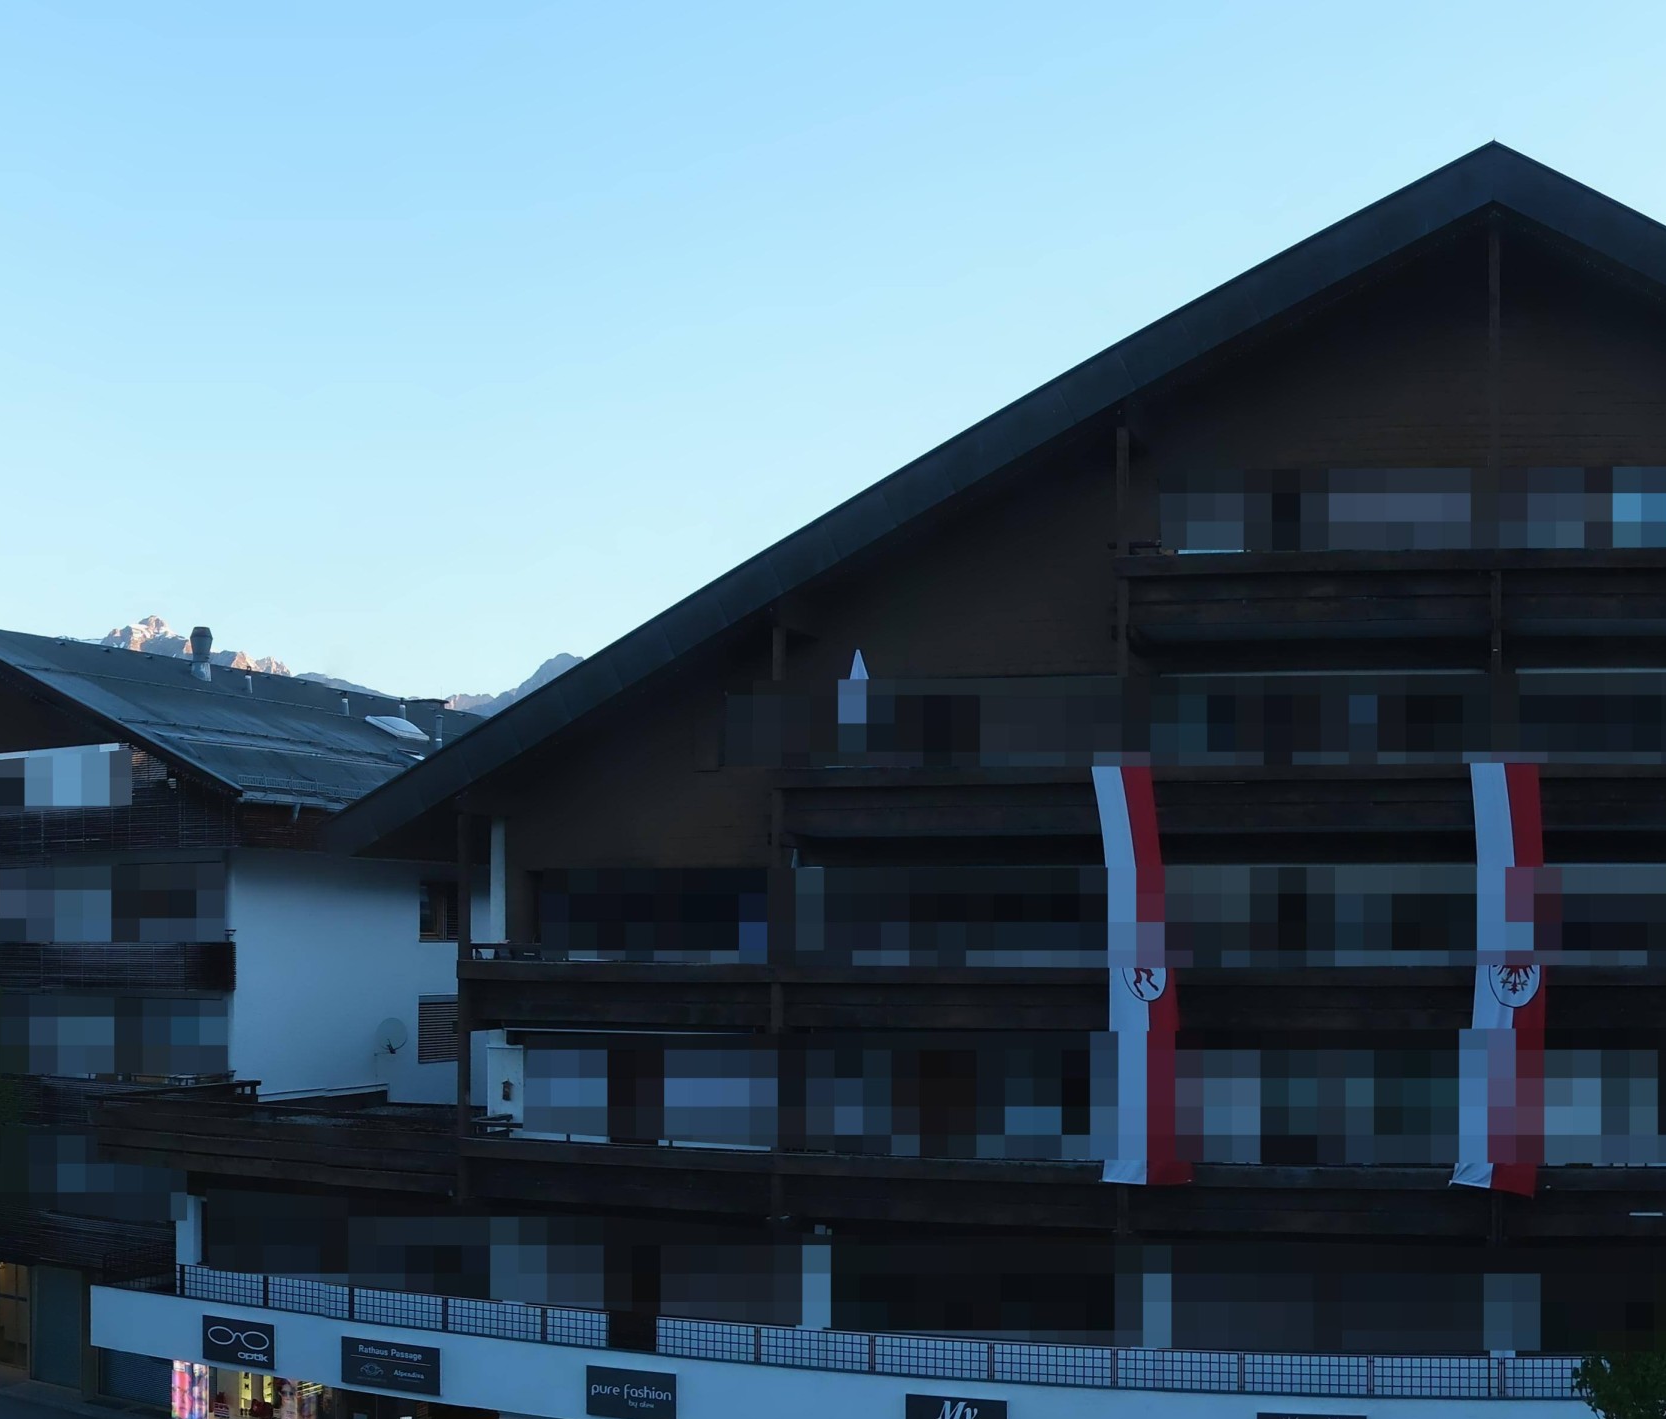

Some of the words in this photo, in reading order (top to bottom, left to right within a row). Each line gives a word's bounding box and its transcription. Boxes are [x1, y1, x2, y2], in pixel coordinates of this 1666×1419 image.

[237, 1351, 269, 1363] optik
[358, 1344, 388, 1356] Rathaus
[390, 1348, 422, 1361] Passage
[591, 1384, 620, 1397] pure
[624, 1383, 672, 1401] fashion
